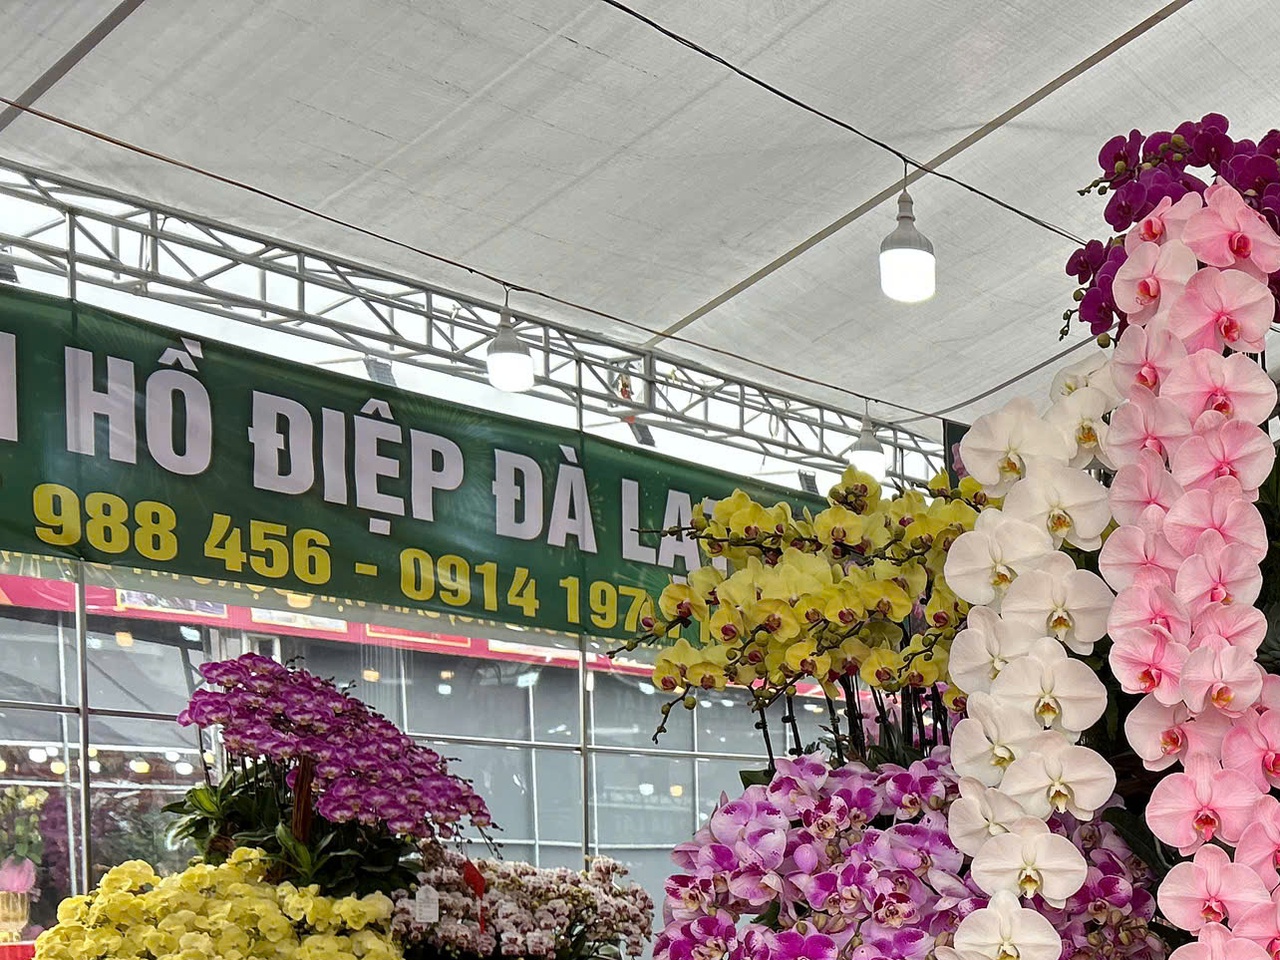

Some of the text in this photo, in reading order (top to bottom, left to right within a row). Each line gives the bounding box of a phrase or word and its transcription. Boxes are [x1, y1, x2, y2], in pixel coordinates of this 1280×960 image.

[65, 337, 213, 475] HỒ
[248, 391, 464, 536] ĐIỆP
[492, 444, 597, 554] ĐÀ
[33, 483, 178, 561] 988
[204, 513, 331, 585] 456
[400, 548, 540, 617] 0914
